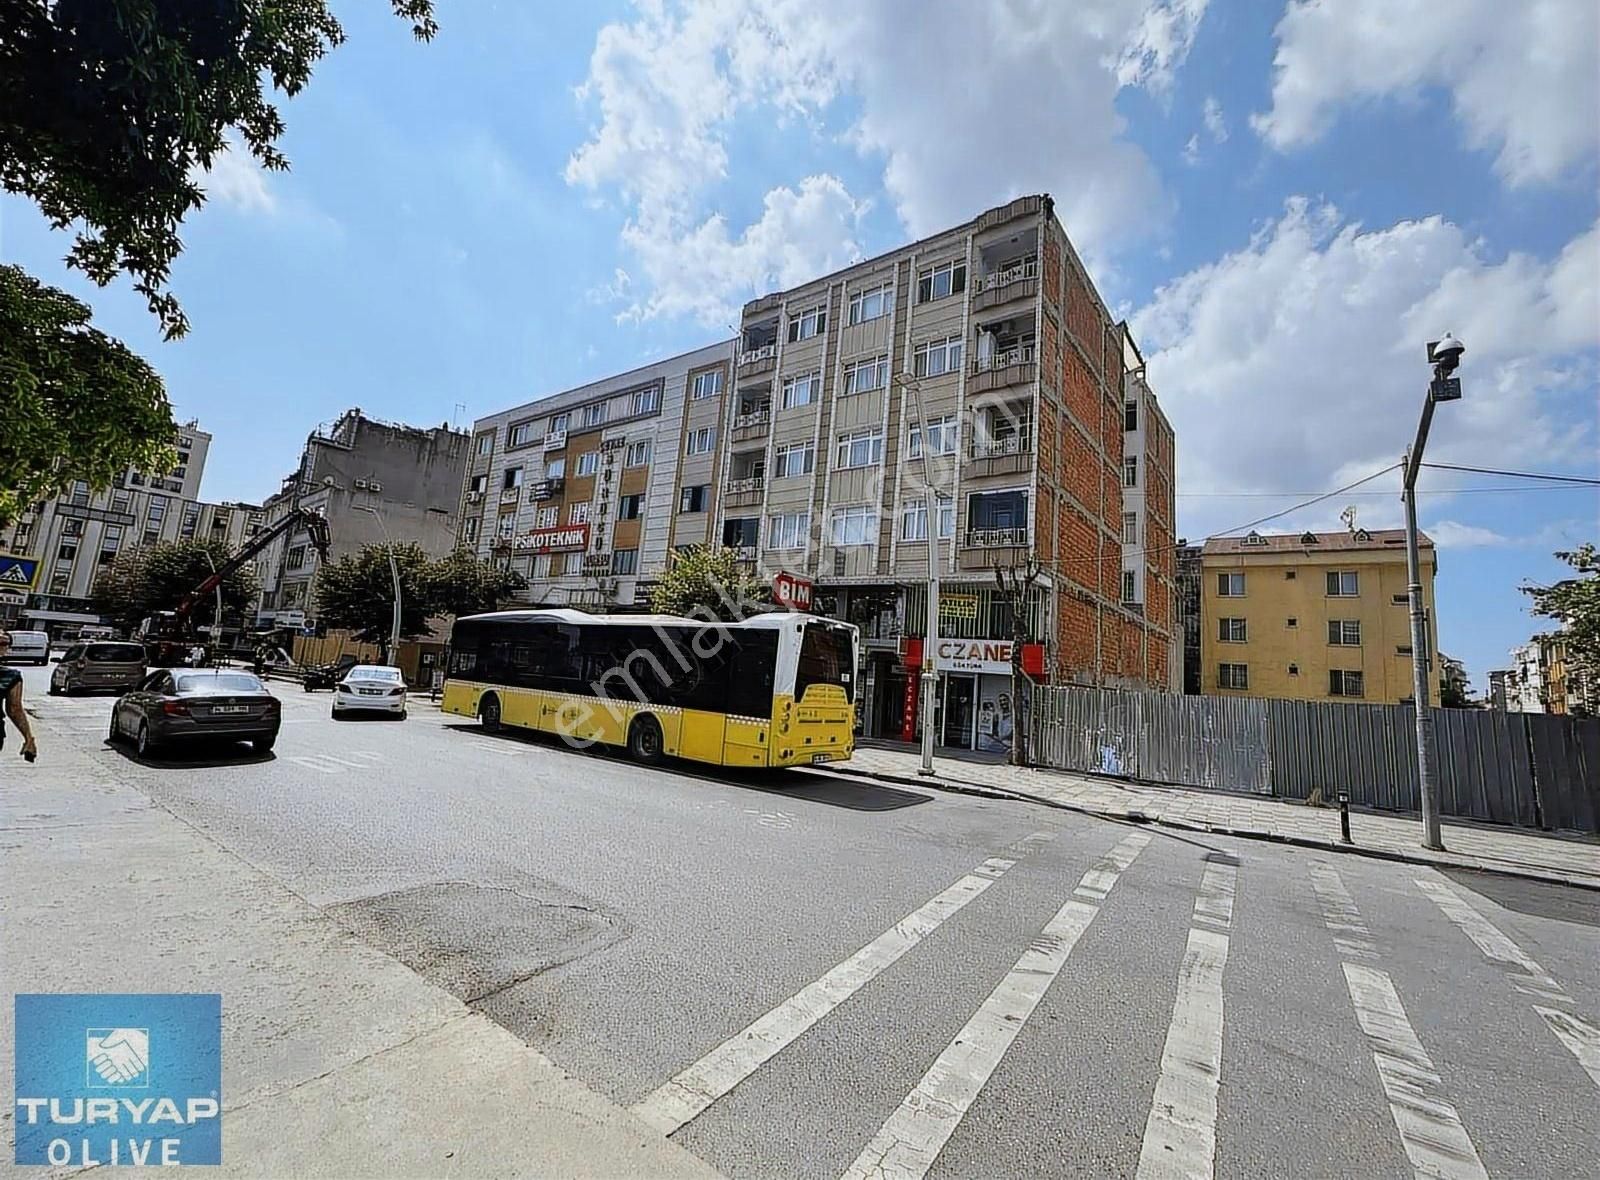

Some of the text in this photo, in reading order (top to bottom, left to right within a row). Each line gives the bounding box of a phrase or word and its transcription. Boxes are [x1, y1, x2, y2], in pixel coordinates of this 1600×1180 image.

[780, 577, 810, 604] BİM
[938, 643, 1012, 662] CZANE
[905, 676, 914, 731] ECZANE
